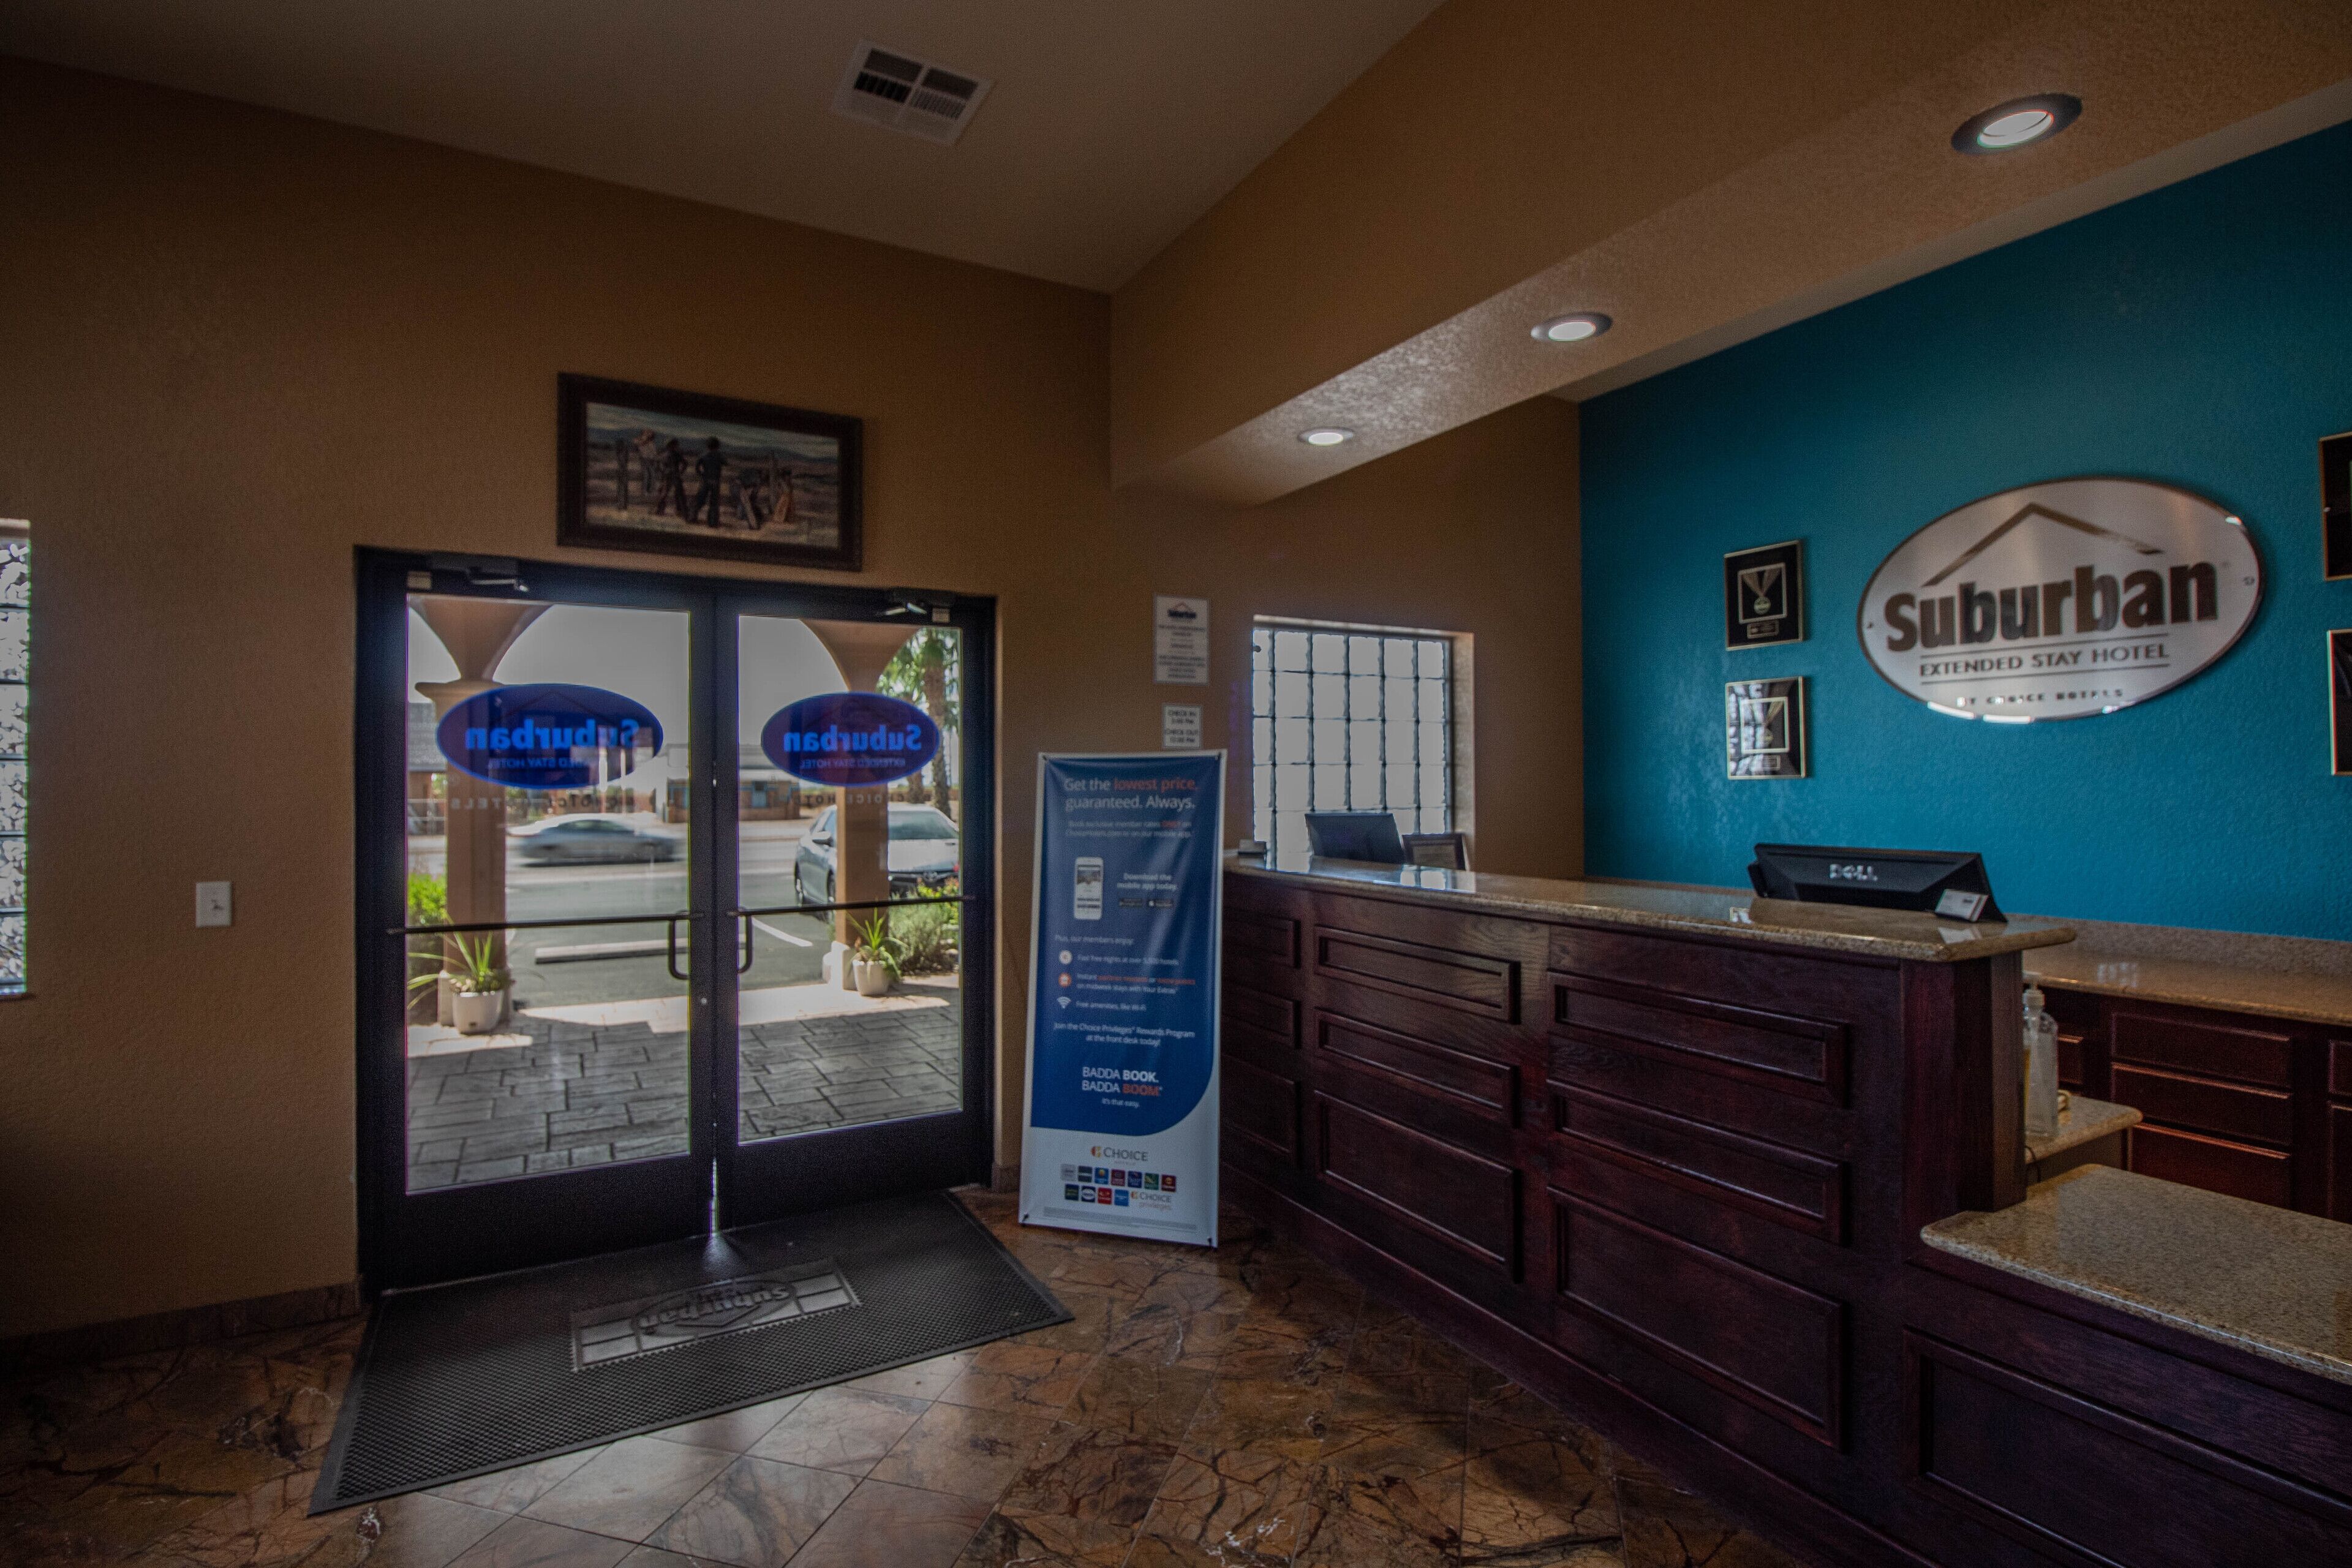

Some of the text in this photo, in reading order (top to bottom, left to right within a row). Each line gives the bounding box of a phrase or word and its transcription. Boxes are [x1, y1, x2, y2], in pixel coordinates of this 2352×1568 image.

[1883, 561, 2218, 652] Suburban
[1920, 644, 2169, 676] EXTENDED STAY HOTEL
[2056, 690, 2123, 701] HOTELS
[1065, 778, 1086, 791] Get
[1089, 778, 1110, 791] the
[1114, 778, 1157, 791] lowest
[1065, 794, 1195, 813] guaranteed. Always.
[1829, 864, 1878, 881] DELL
[1082, 1066, 1159, 1083] BADDA BOOK.
[1082, 1080, 1120, 1093] BADDA
[1103, 1147, 1148, 1162] CHOICE
[1139, 1191, 1171, 1203] CHOICE
